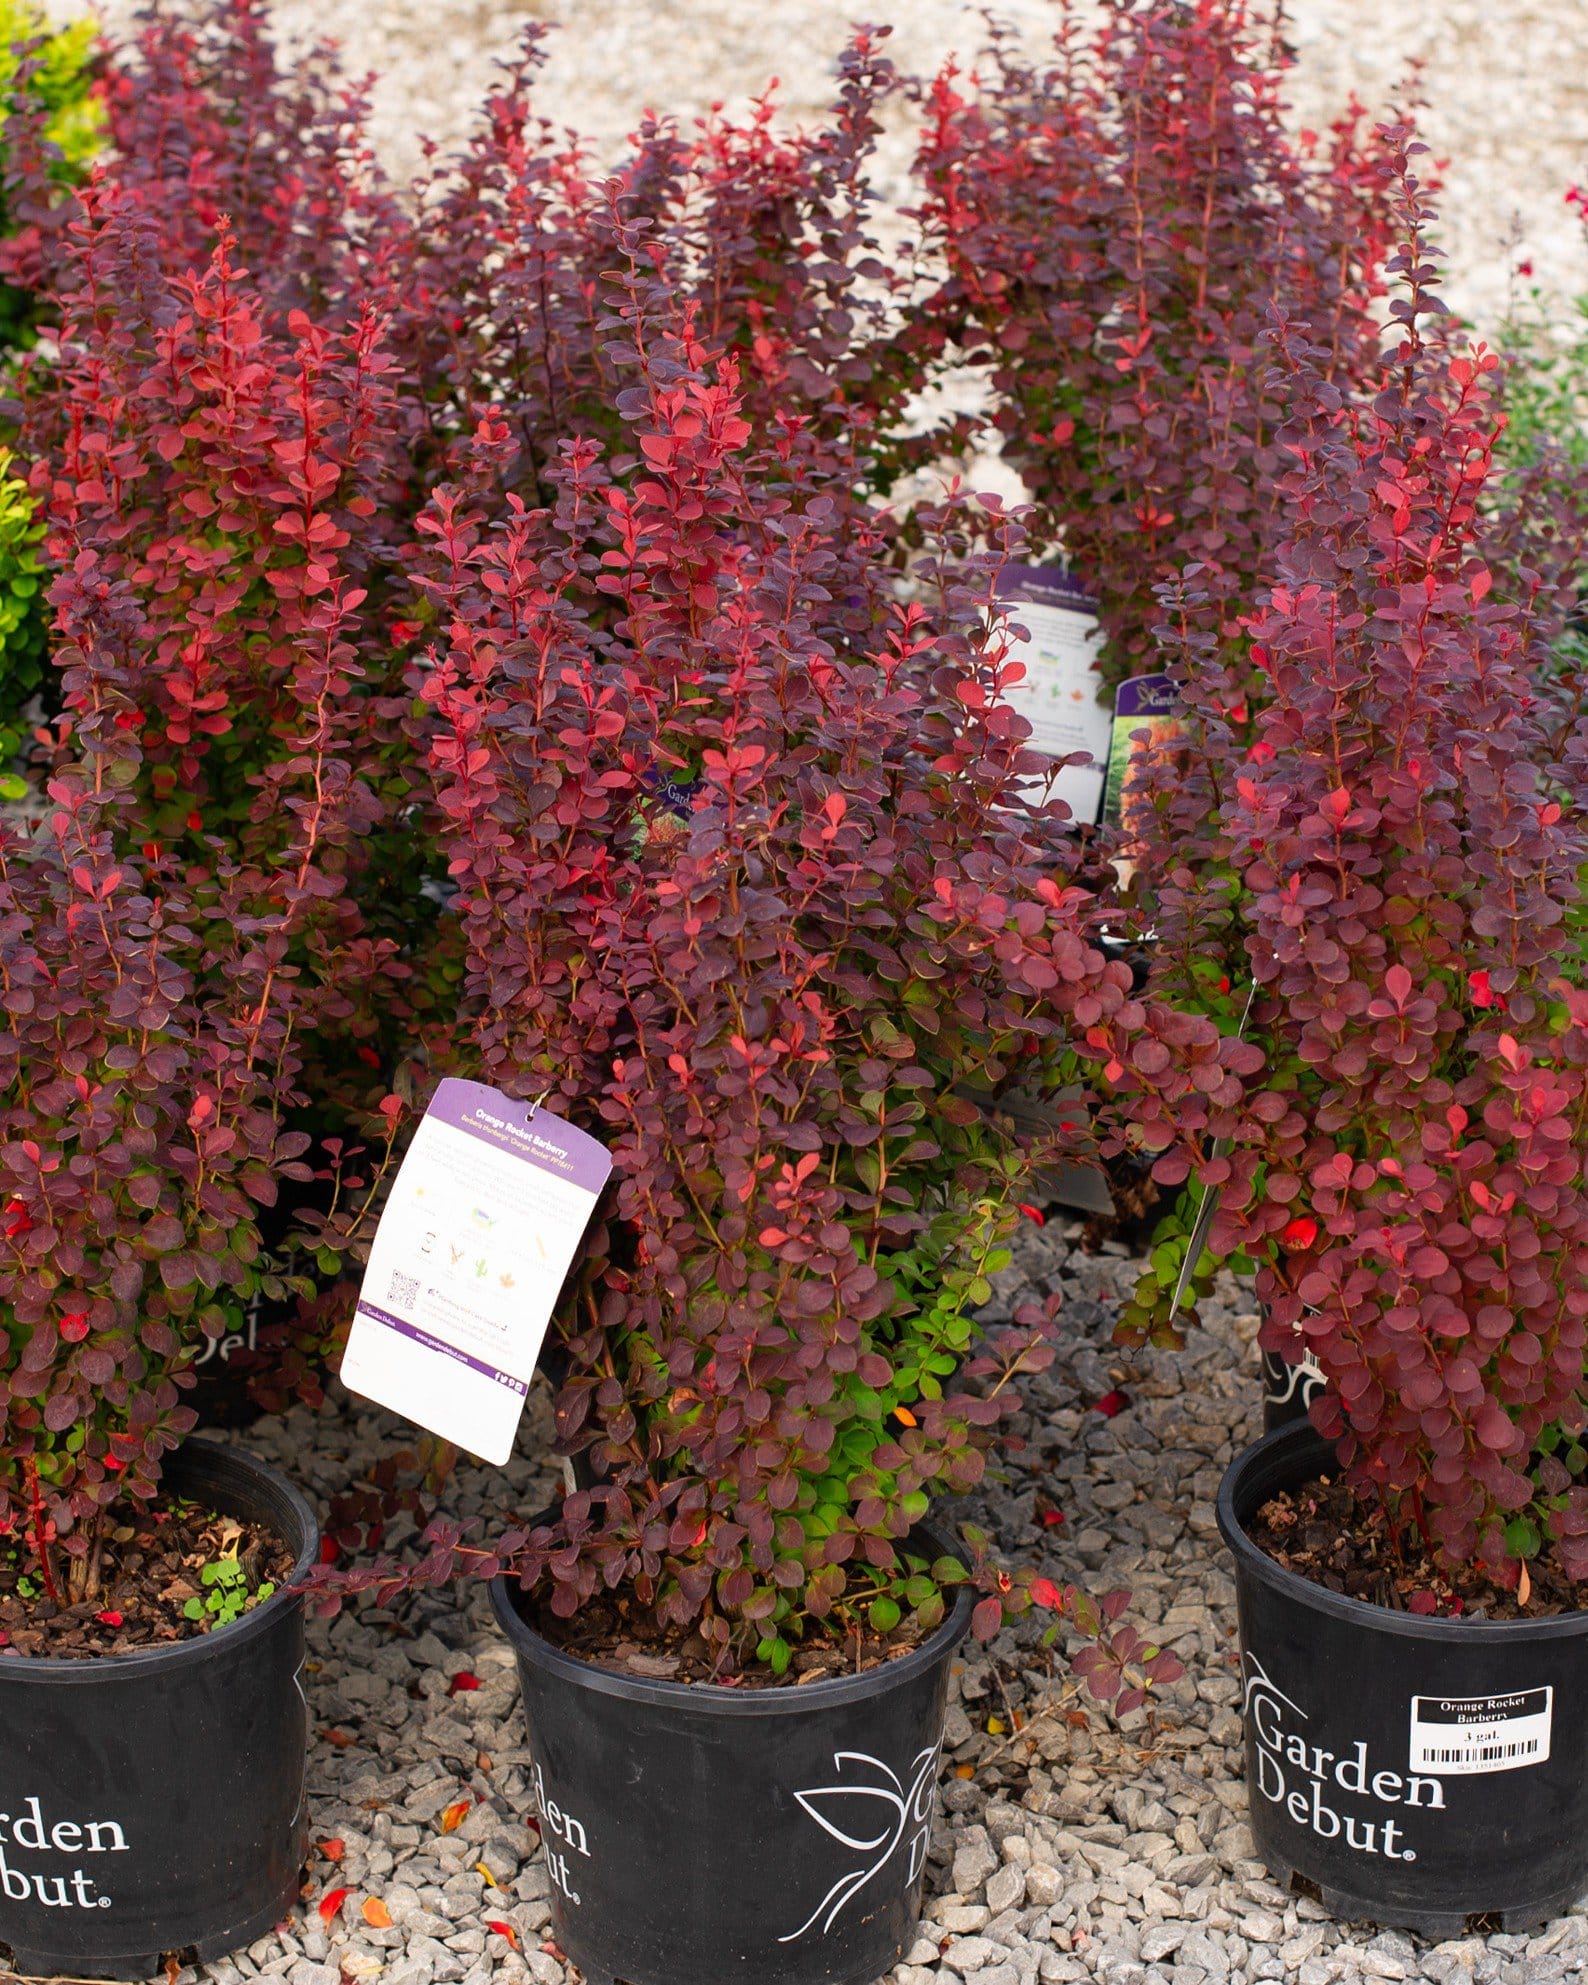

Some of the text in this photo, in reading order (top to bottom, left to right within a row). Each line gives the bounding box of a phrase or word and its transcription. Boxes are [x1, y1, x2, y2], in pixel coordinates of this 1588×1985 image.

[475, 1108, 568, 1160] Orange Rocket Barberry
[1440, 1697, 1525, 1712] Orange Rocket
[1254, 1693, 1447, 1809] Garden
[1464, 1731, 1472, 1742] 3
